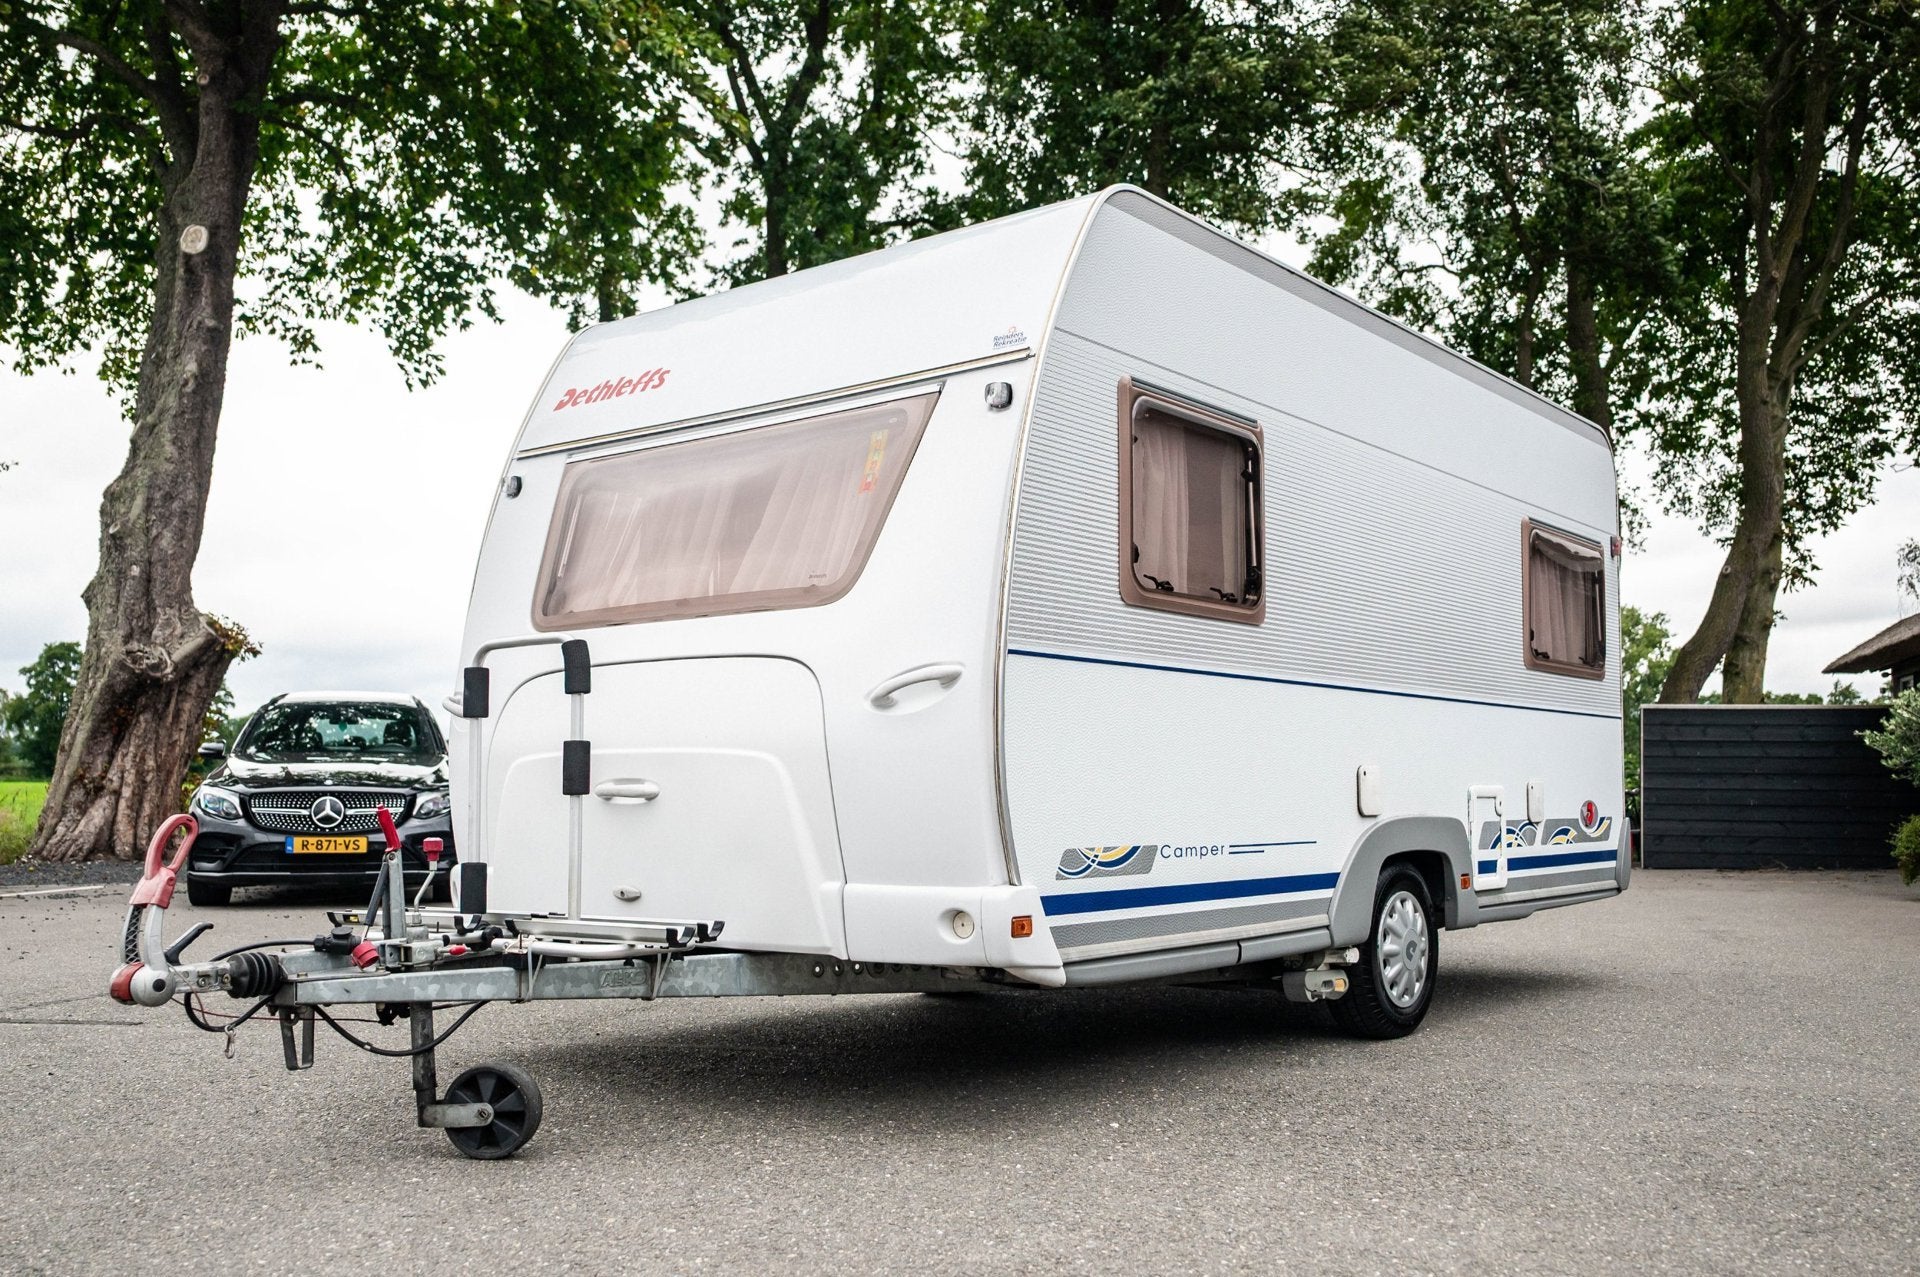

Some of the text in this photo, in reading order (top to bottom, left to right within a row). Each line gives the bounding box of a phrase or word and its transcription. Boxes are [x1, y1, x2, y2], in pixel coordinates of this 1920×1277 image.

[553, 367, 671, 411] Dethleffs
[301, 839, 360, 851] R-871-VS
[1160, 844, 1225, 860] Camper
